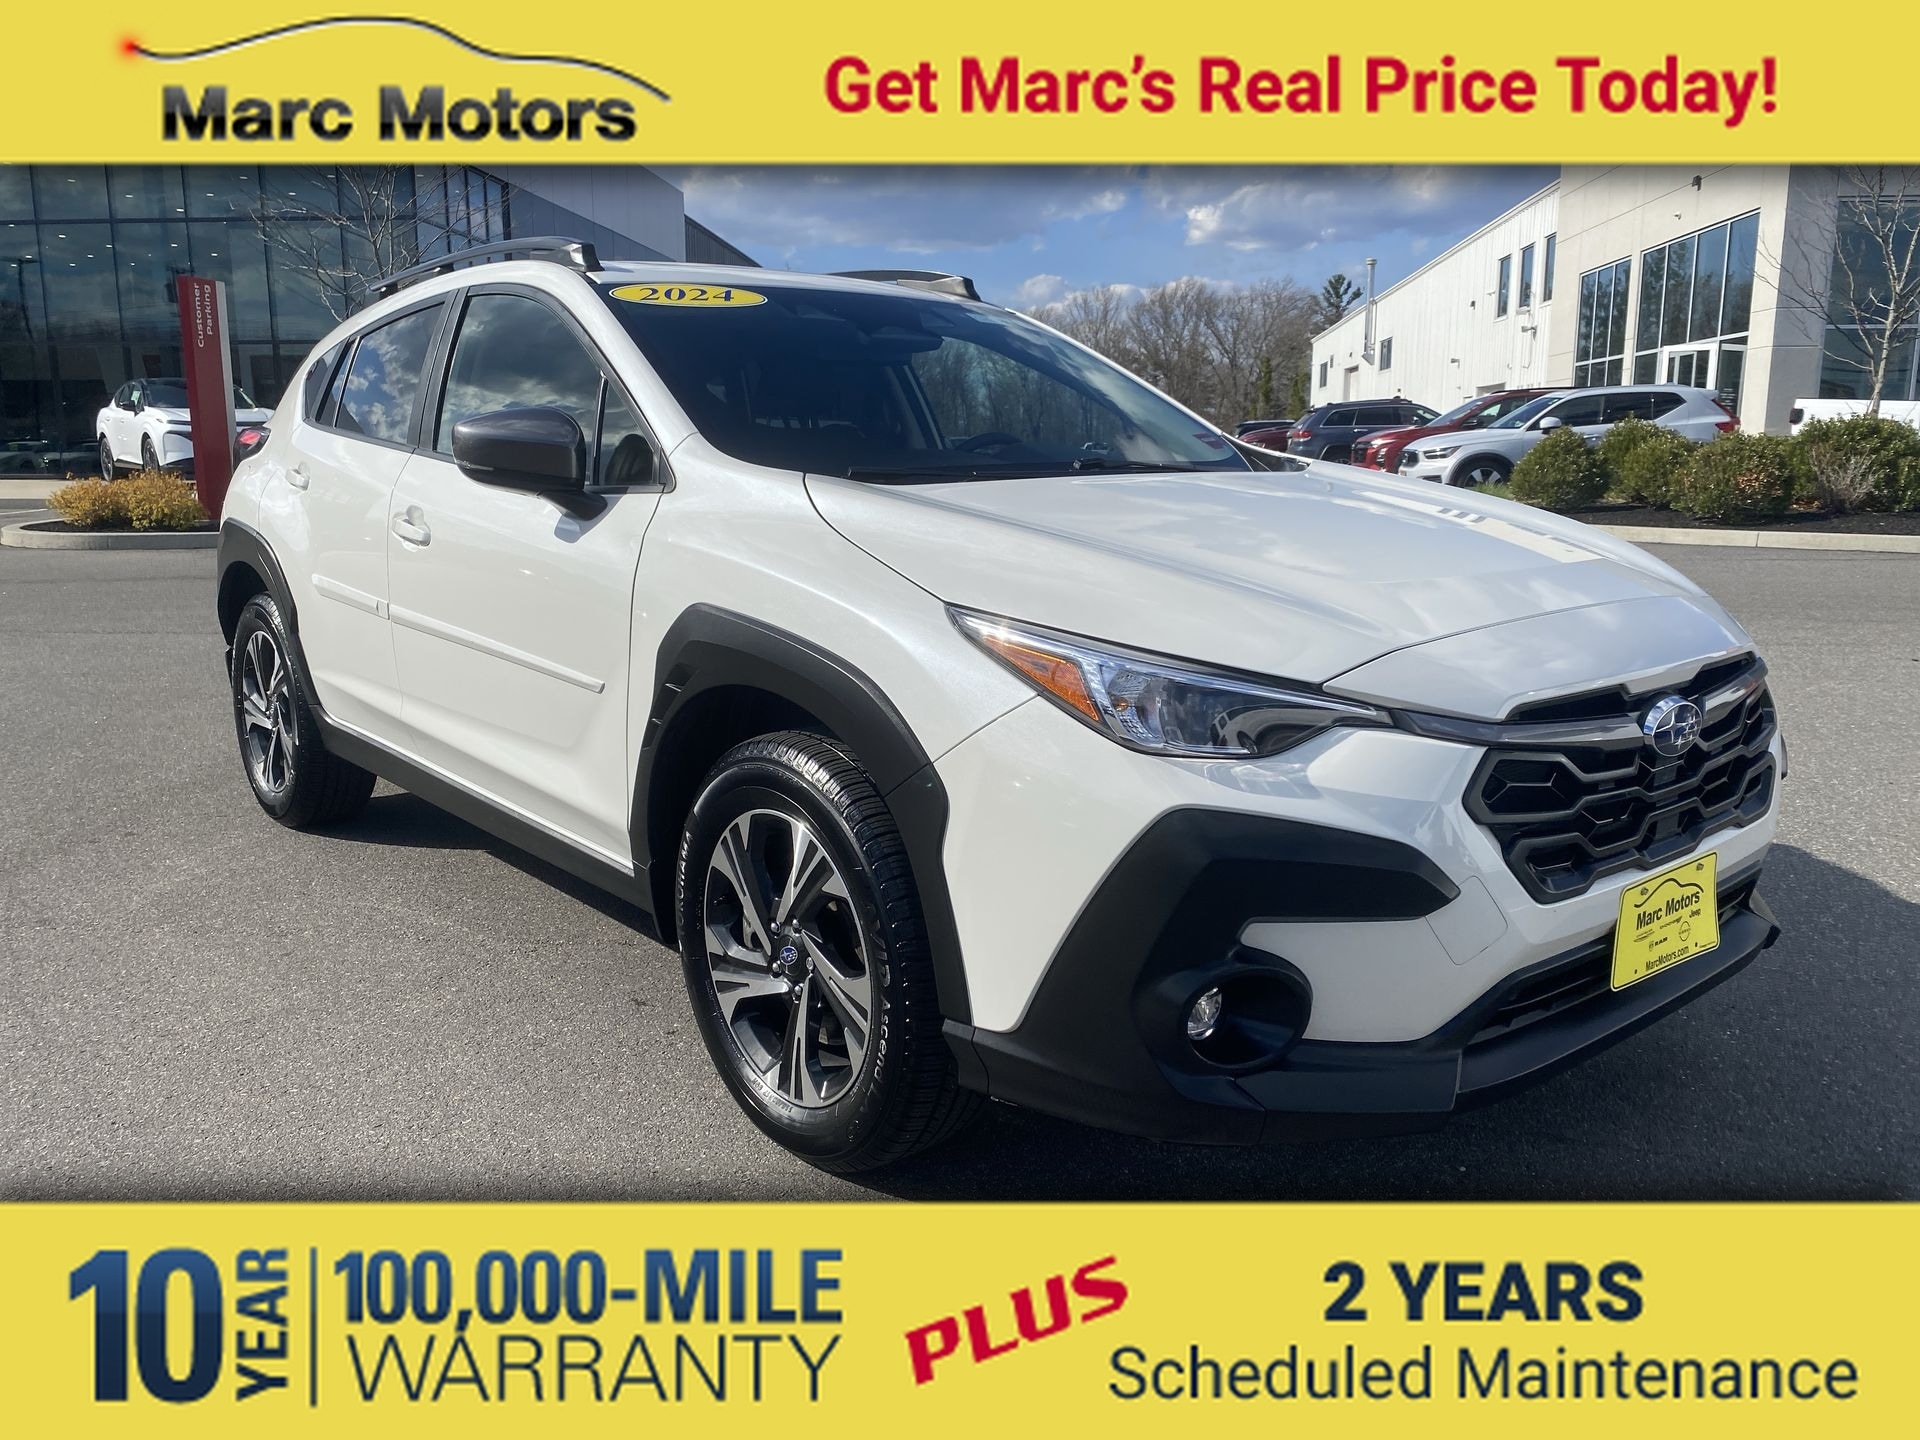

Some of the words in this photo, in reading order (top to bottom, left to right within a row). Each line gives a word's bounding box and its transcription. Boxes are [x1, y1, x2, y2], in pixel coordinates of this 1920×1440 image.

[204, 285, 213, 335] Parking
[640, 287, 734, 302] 2024
[194, 283, 204, 348] Customer
[1636, 907, 1662, 930] Marc
[1665, 891, 1700, 917] Motors
[1689, 908, 1701, 918] Jeep
[1645, 946, 1690, 972] MarcMotors.com
[873, 997, 892, 1085] Ascend
